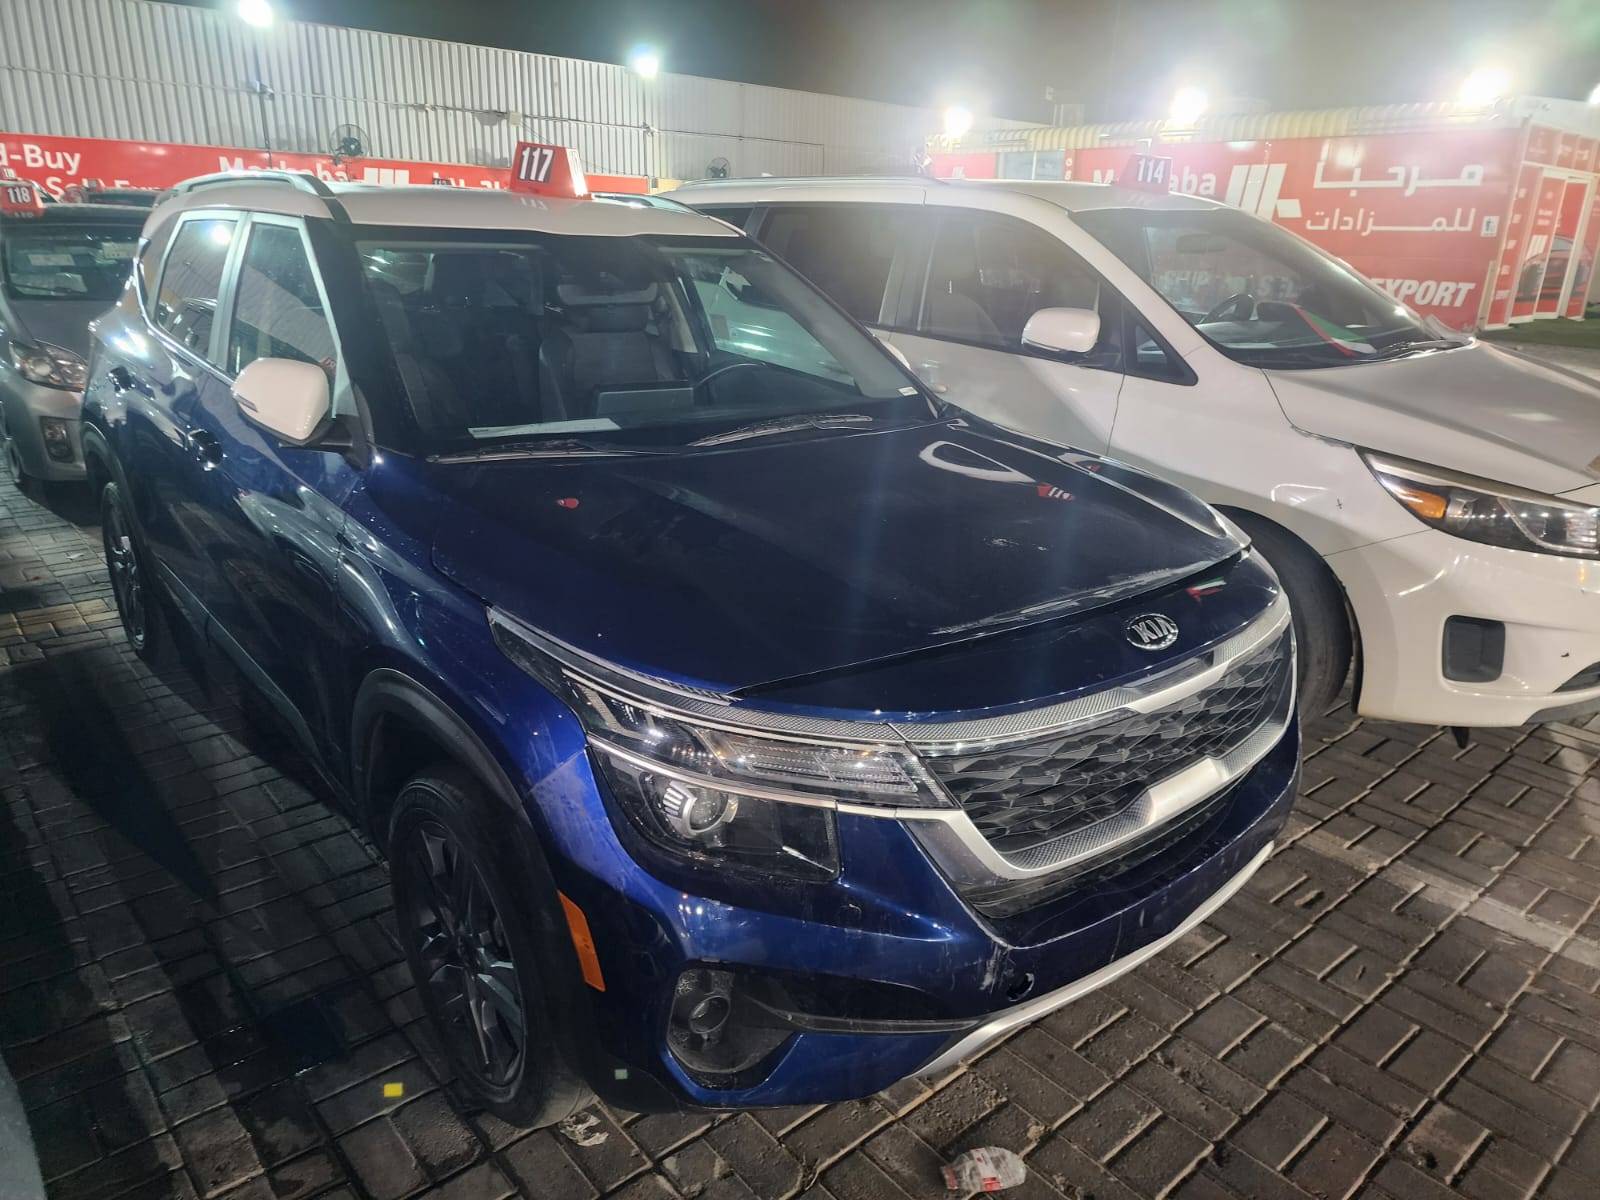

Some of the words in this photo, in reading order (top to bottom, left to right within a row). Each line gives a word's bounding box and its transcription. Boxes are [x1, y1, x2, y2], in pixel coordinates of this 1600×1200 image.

[520, 147, 554, 182] 117
[1137, 158, 1166, 183] 114
[8, 186, 31, 204] 118
[1306, 208, 1476, 236] للمزادات
[1131, 617, 1175, 643] KIA
